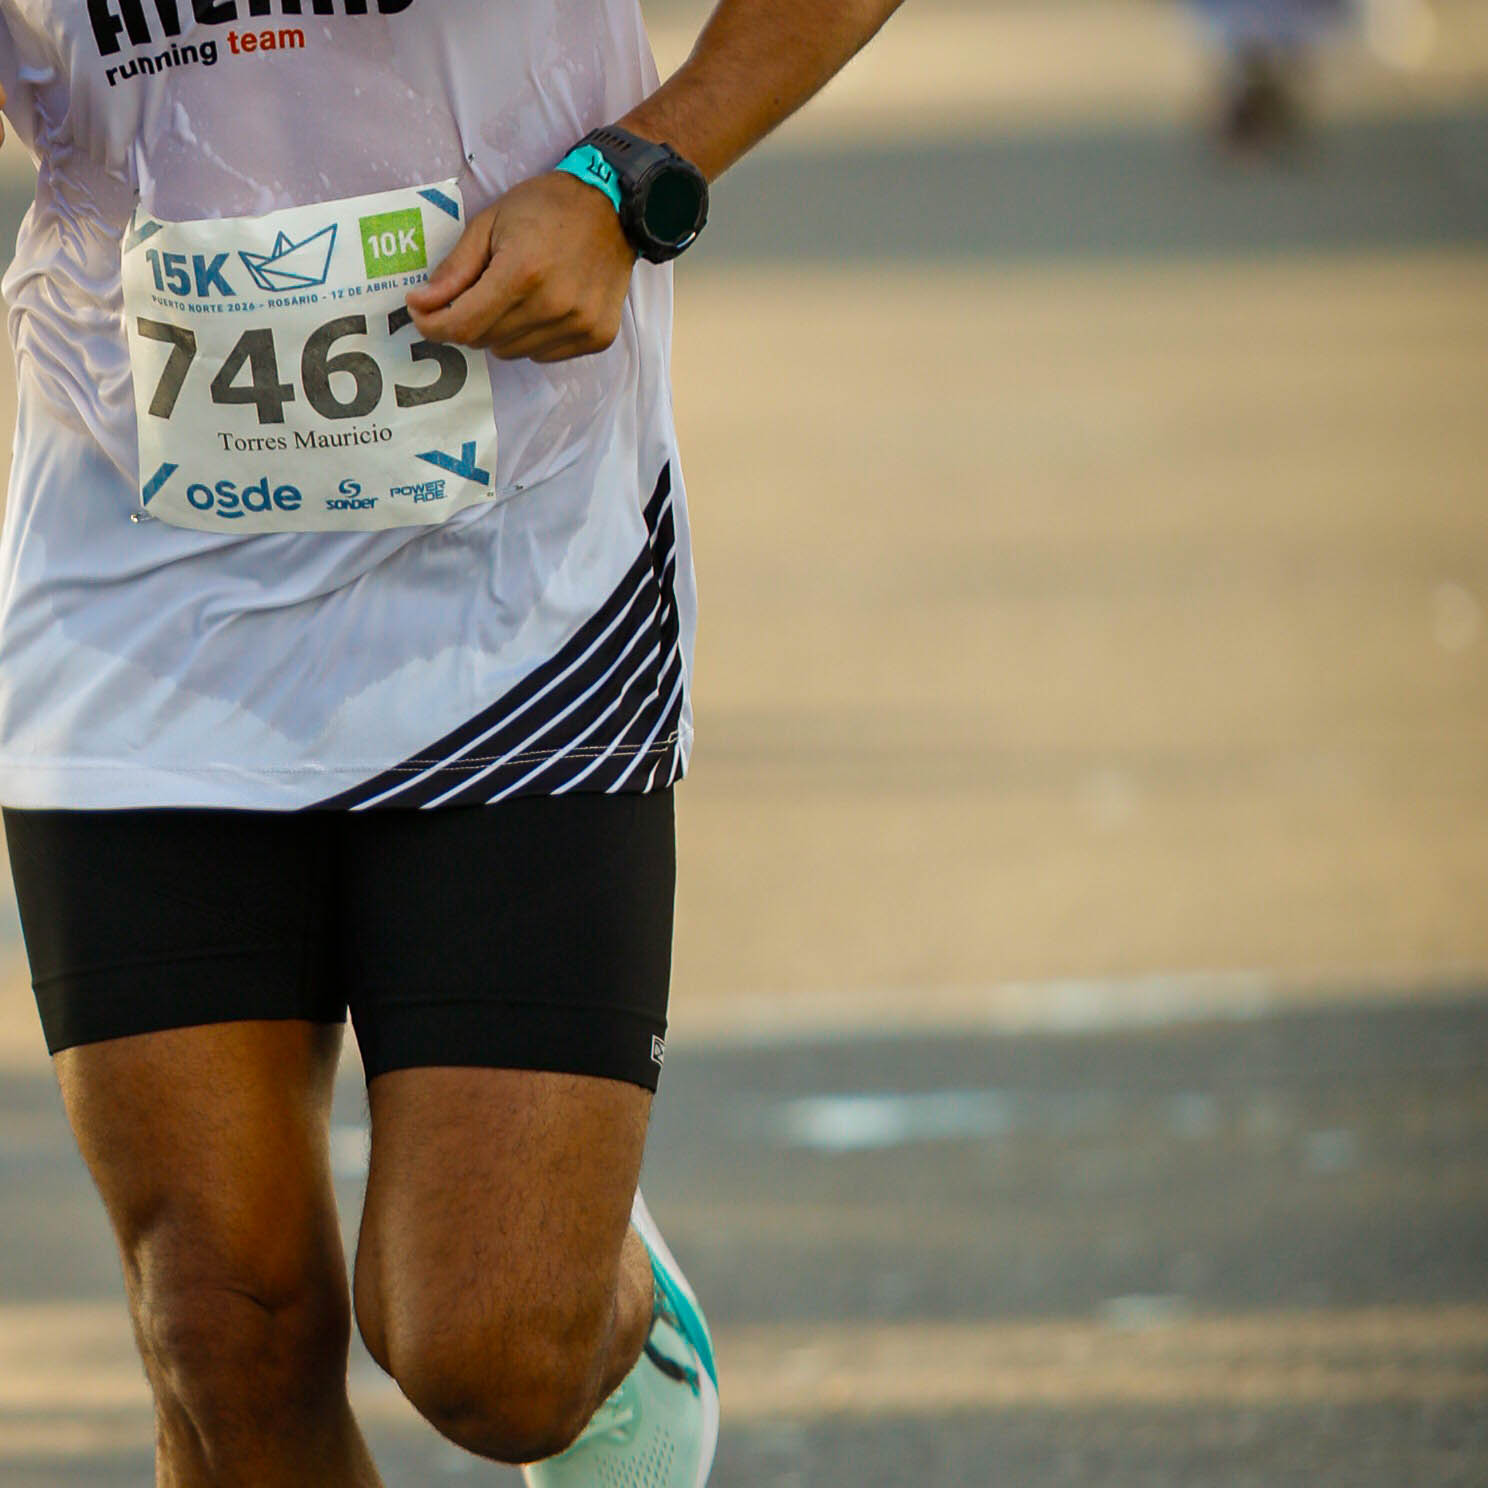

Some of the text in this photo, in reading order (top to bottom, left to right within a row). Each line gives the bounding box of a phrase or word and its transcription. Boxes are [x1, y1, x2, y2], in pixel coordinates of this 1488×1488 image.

[105, 27, 305, 87] running team
[367, 227, 418, 259] 10K
[145, 248, 236, 297] 15K
[151, 295, 185, 311] PUERTO
[188, 303, 223, 313] NORTE
[228, 303, 255, 312] 2026
[331, 290, 344, 300] 12
[348, 286, 362, 297] DE
[366, 279, 399, 294] ABRIL
[136, 306, 468, 424] 7463
[218, 424, 393, 452] Torres Mauricio
[186, 476, 302, 512] osde
[390, 479, 446, 497] POWER
